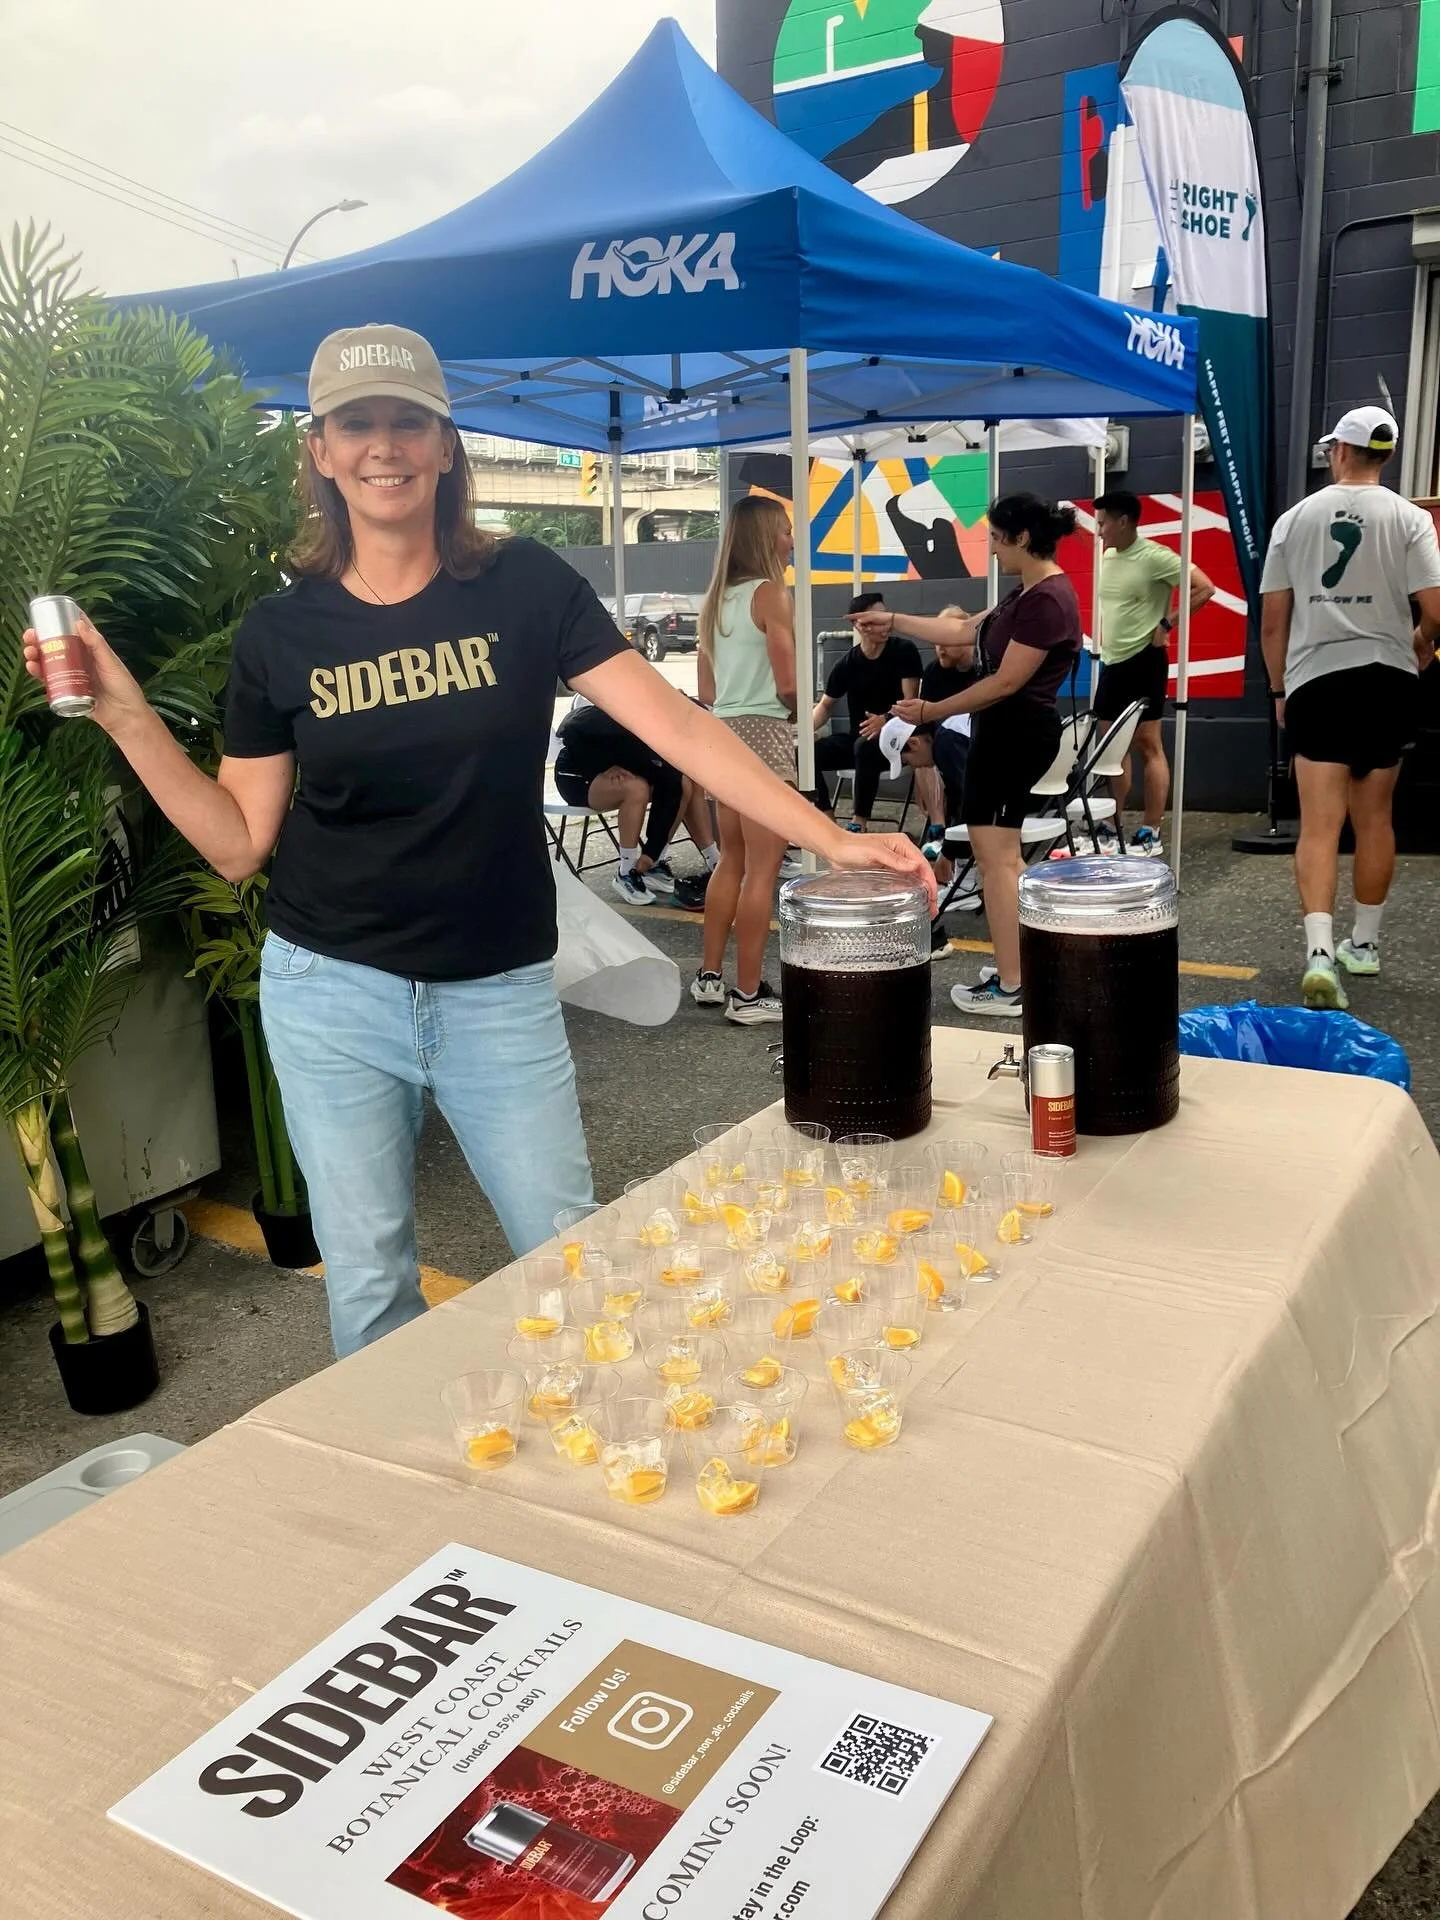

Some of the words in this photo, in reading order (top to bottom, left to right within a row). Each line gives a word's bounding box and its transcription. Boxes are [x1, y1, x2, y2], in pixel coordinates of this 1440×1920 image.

[1181, 208, 1231, 239] SHOE
[1182, 182, 1239, 213] RIGHT
[569, 231, 740, 300] HOKA
[339, 343, 416, 372] SIDEBAR
[1204, 358, 1222, 406] HAPPY
[1216, 410, 1231, 445] FEET
[1227, 460, 1244, 505] HAPPY
[1239, 508, 1260, 560] PEOPLE
[309, 636, 499, 719] SIDEBAR
[198, 1583, 518, 1819] SIDEBAR
[326, 1726, 473, 1856] BOTANICAL
[467, 1618, 583, 1721] COCKTAILS
[360, 1717, 437, 1780] WEST
[434, 1651, 509, 1715] COAST
[452, 1739, 491, 1774] (Under
[487, 1713, 520, 1739] 0.5%
[515, 1688, 547, 1713] ABV)
[558, 1690, 609, 1733] Follow
[599, 1668, 631, 1691] Us!
[661, 1689, 755, 1795] @sidebar_non_alc_cocktails
[642, 1816, 736, 1920] COMING
[725, 1743, 792, 1815] SOON!
[749, 1881, 774, 1898] in
[763, 1855, 791, 1881] the
[780, 1815, 820, 1855] Loop:
